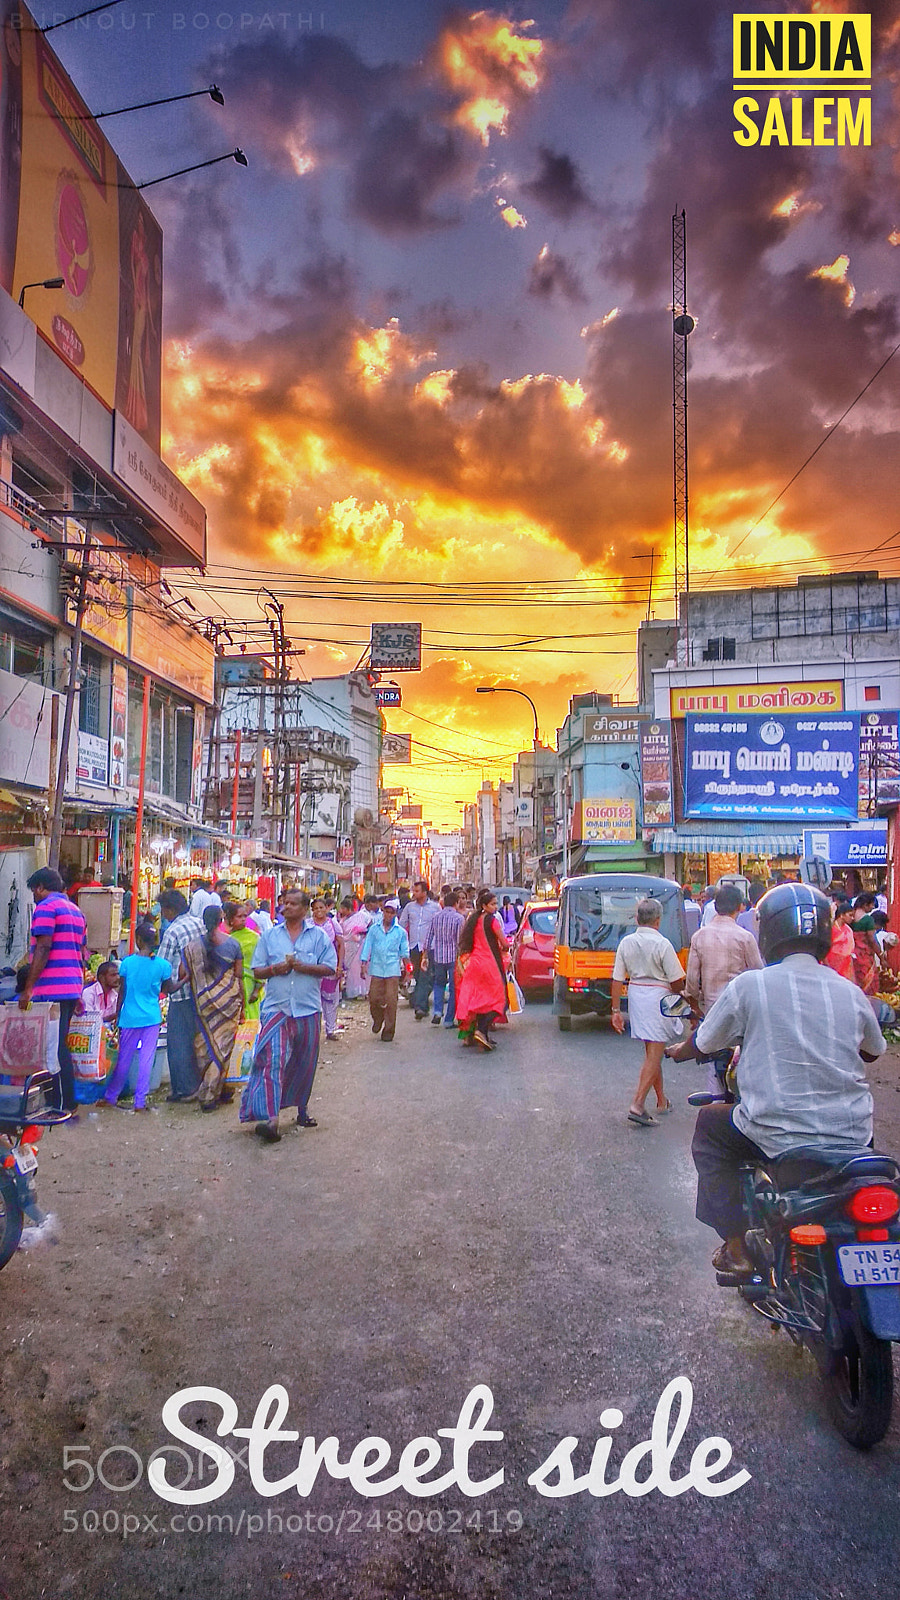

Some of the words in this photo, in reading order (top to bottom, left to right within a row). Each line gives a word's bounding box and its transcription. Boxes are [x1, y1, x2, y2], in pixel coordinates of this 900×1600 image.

[380, 634, 415, 648] KJS
[375, 693, 400, 701] NDRA
[679, 695, 728, 713] பாபு
[738, 687, 837, 709] மளிகை
[643, 735, 669, 747] பாபு
[692, 750, 731, 778] பாபு
[736, 743, 792, 771] பொரி
[796, 739, 855, 779] மண்டி
[854, 1251, 878, 1264] TN
[853, 1269, 866, 1282] H
